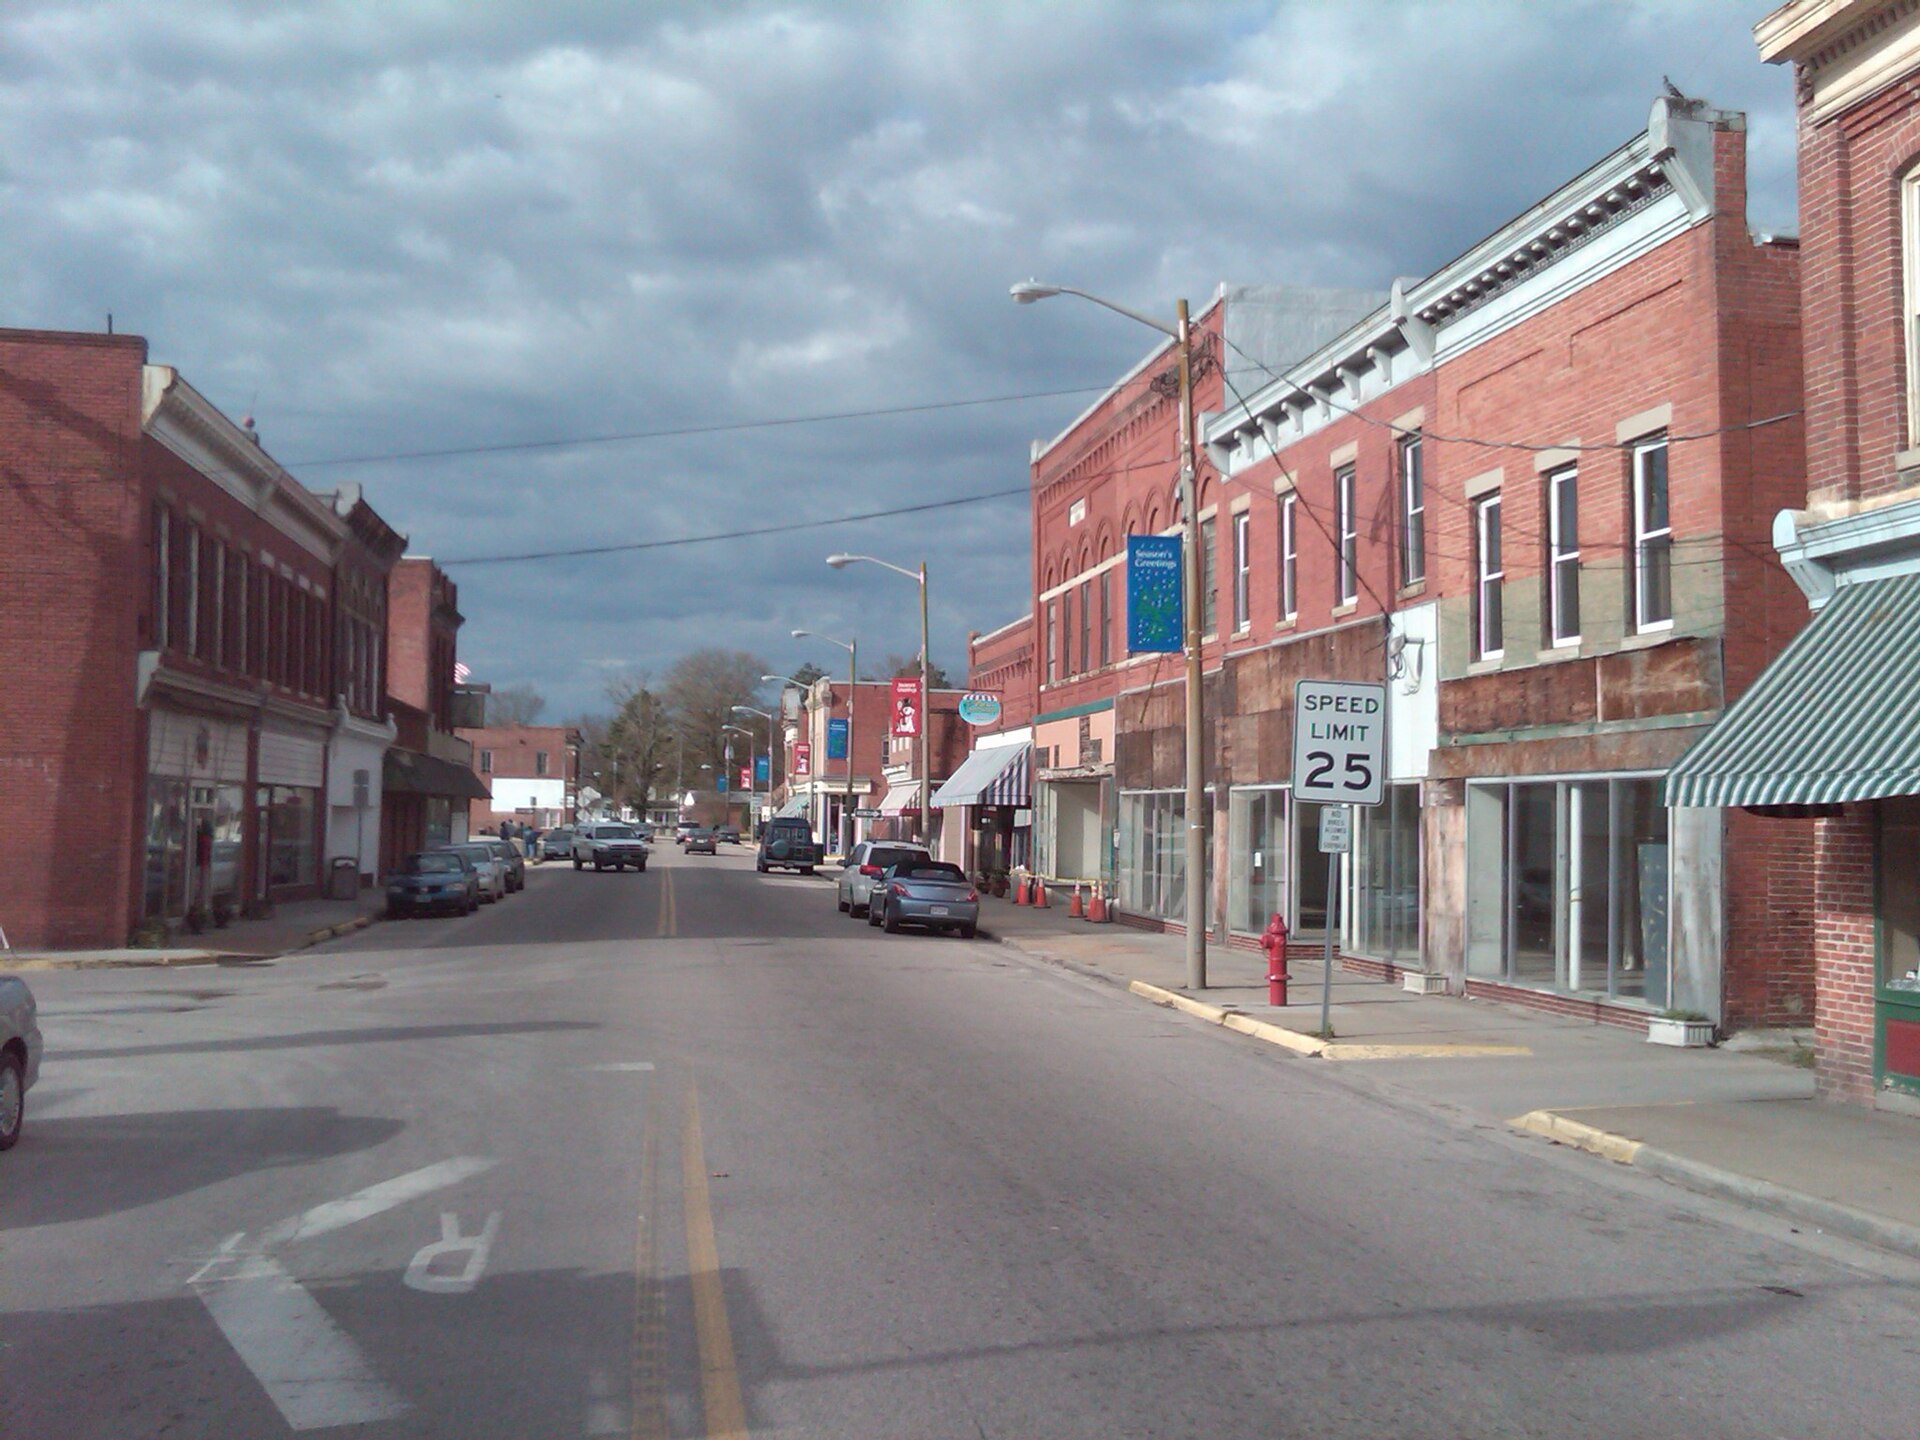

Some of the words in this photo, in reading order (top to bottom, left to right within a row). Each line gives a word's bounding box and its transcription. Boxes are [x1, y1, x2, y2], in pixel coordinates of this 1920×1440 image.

[1134, 559, 1177, 569] Greetings
[1135, 549, 1172, 559] Season's
[1304, 694, 1379, 715] SPEED
[1311, 722, 1370, 742] LIMIT
[1305, 751, 1372, 791] 25
